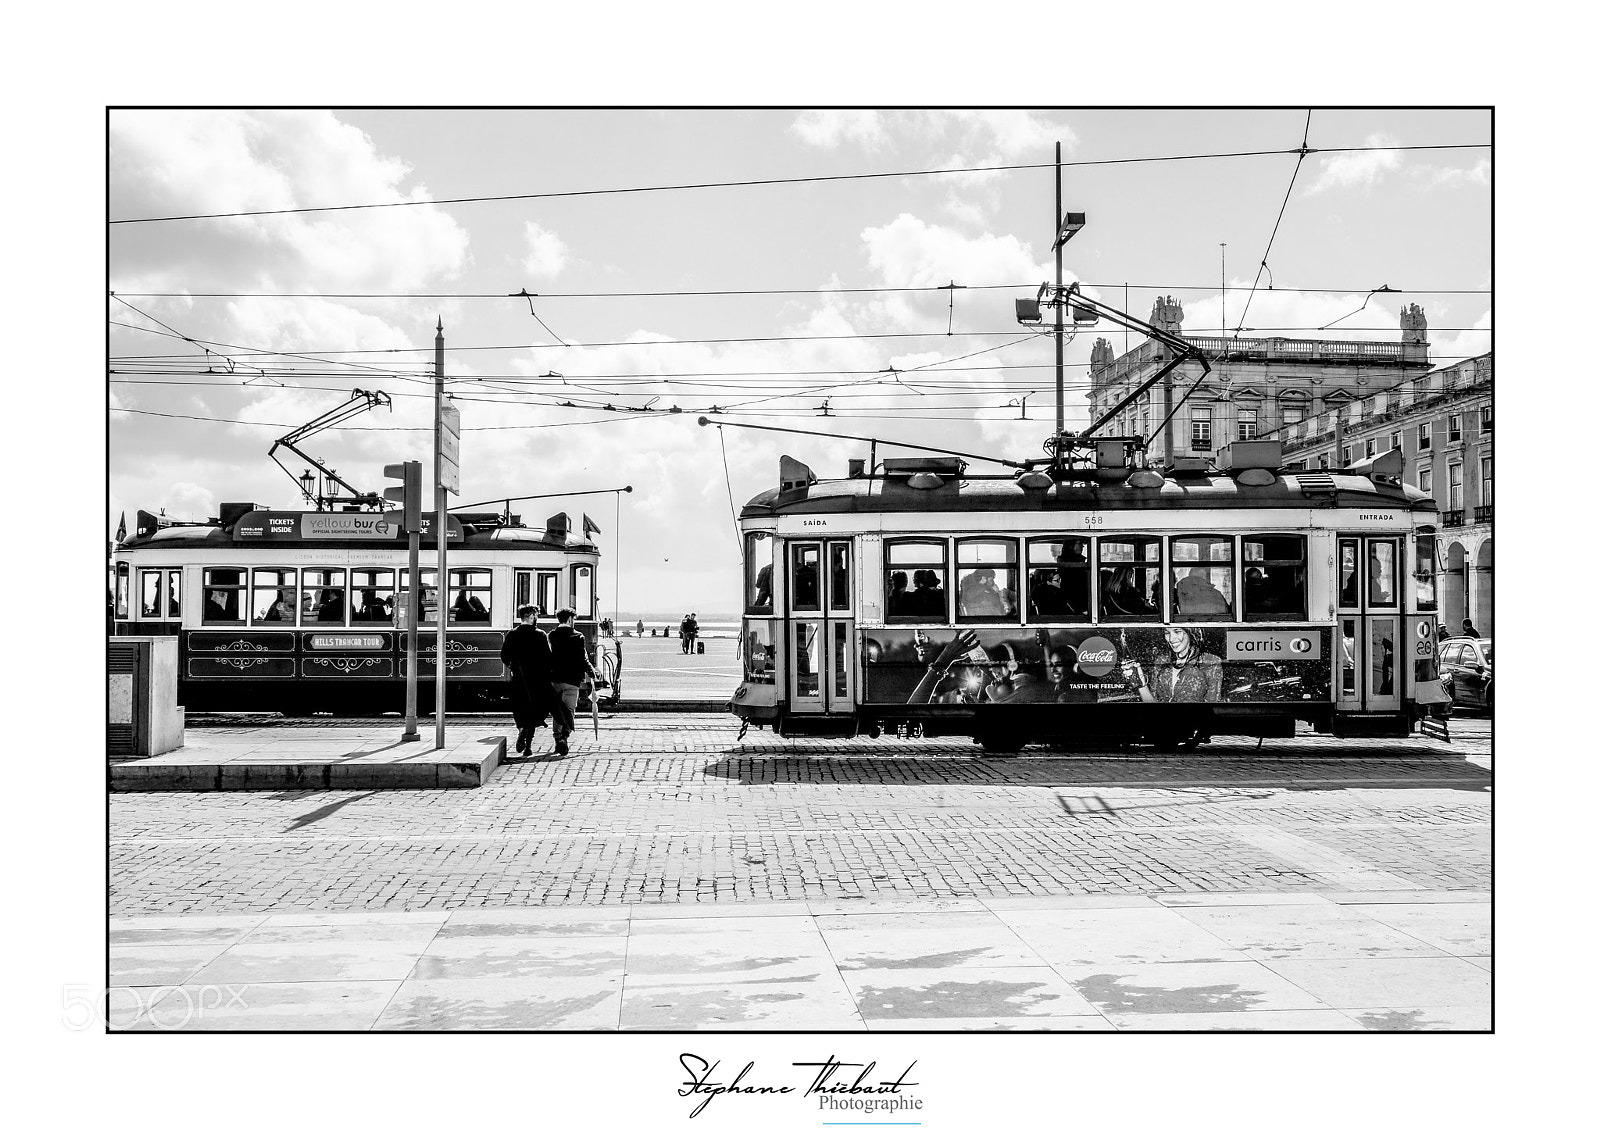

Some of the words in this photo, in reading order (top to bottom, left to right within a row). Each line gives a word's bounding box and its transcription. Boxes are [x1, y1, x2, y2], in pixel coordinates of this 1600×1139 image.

[269, 518, 295, 526] TICKETS
[310, 517, 352, 529] yellow
[353, 517, 374, 529] bus
[803, 518, 827, 526] SAÍDA
[1084, 516, 1103, 525] 558
[314, 638, 334, 646] HILLS
[363, 638, 380, 646] TOUR
[1235, 637, 1282, 652] carris
